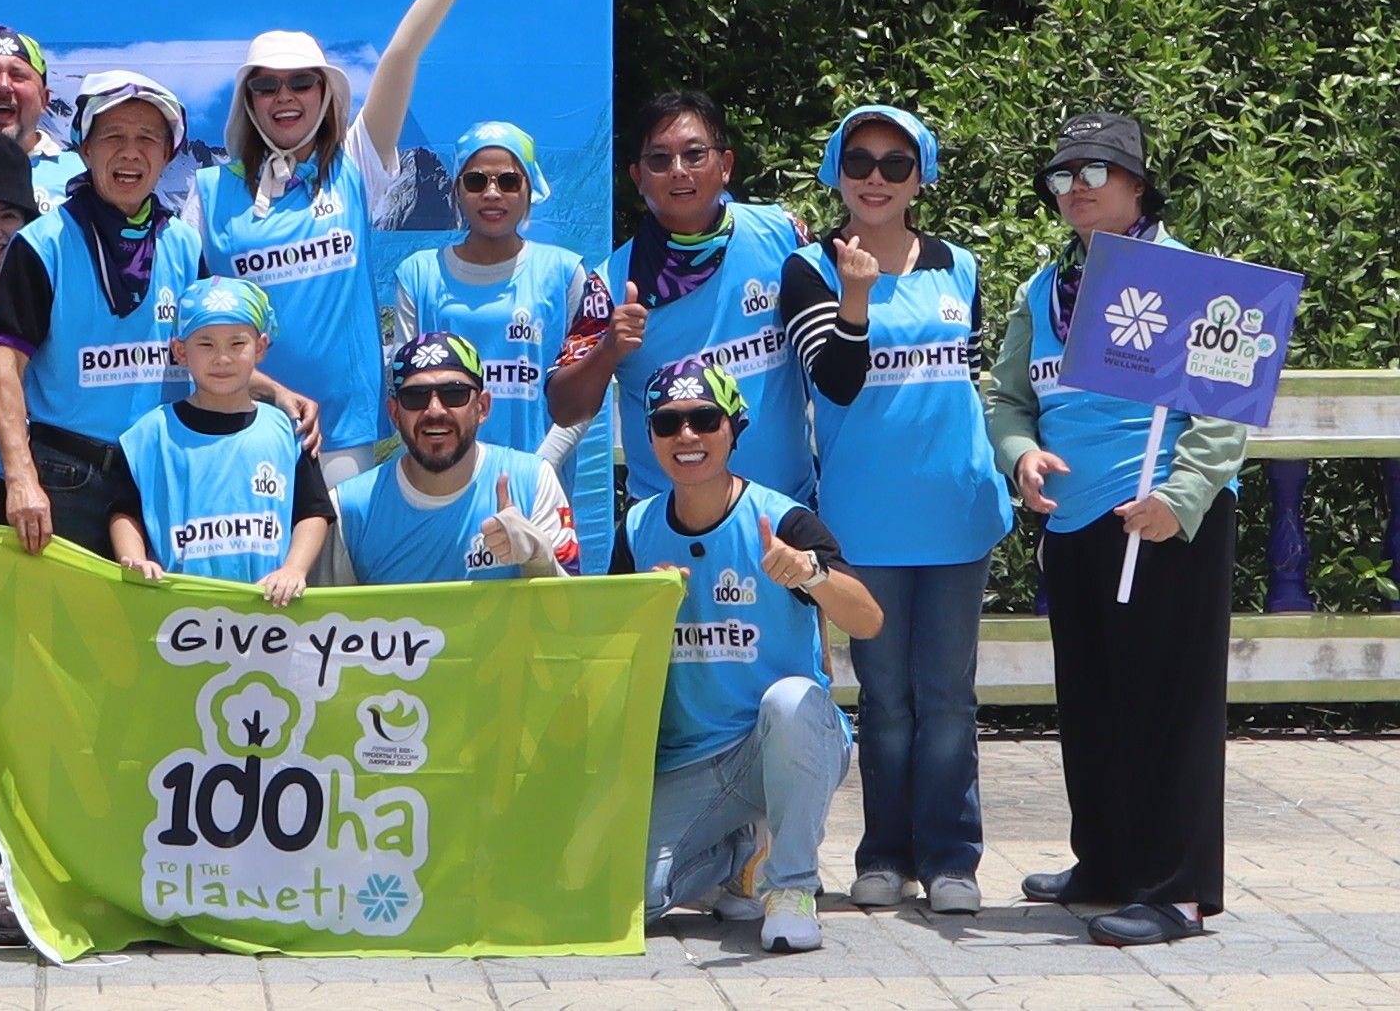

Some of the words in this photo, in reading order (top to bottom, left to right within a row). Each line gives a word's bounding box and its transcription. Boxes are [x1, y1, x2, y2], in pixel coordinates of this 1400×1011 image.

[235, 232, 352, 276] ВОЛОНТЁР
[701, 330, 786, 365] ЛОНТЁР
[867, 342, 967, 372] ОЛОНТЁ
[869, 371, 915, 383] IBERIAN
[920, 367, 967, 380] WELLNE
[673, 623, 755, 647] ЛОНТЁР
[171, 619, 288, 654] Give
[309, 626, 430, 687] your
[157, 861, 178, 874] TO
[198, 863, 231, 876] THE
